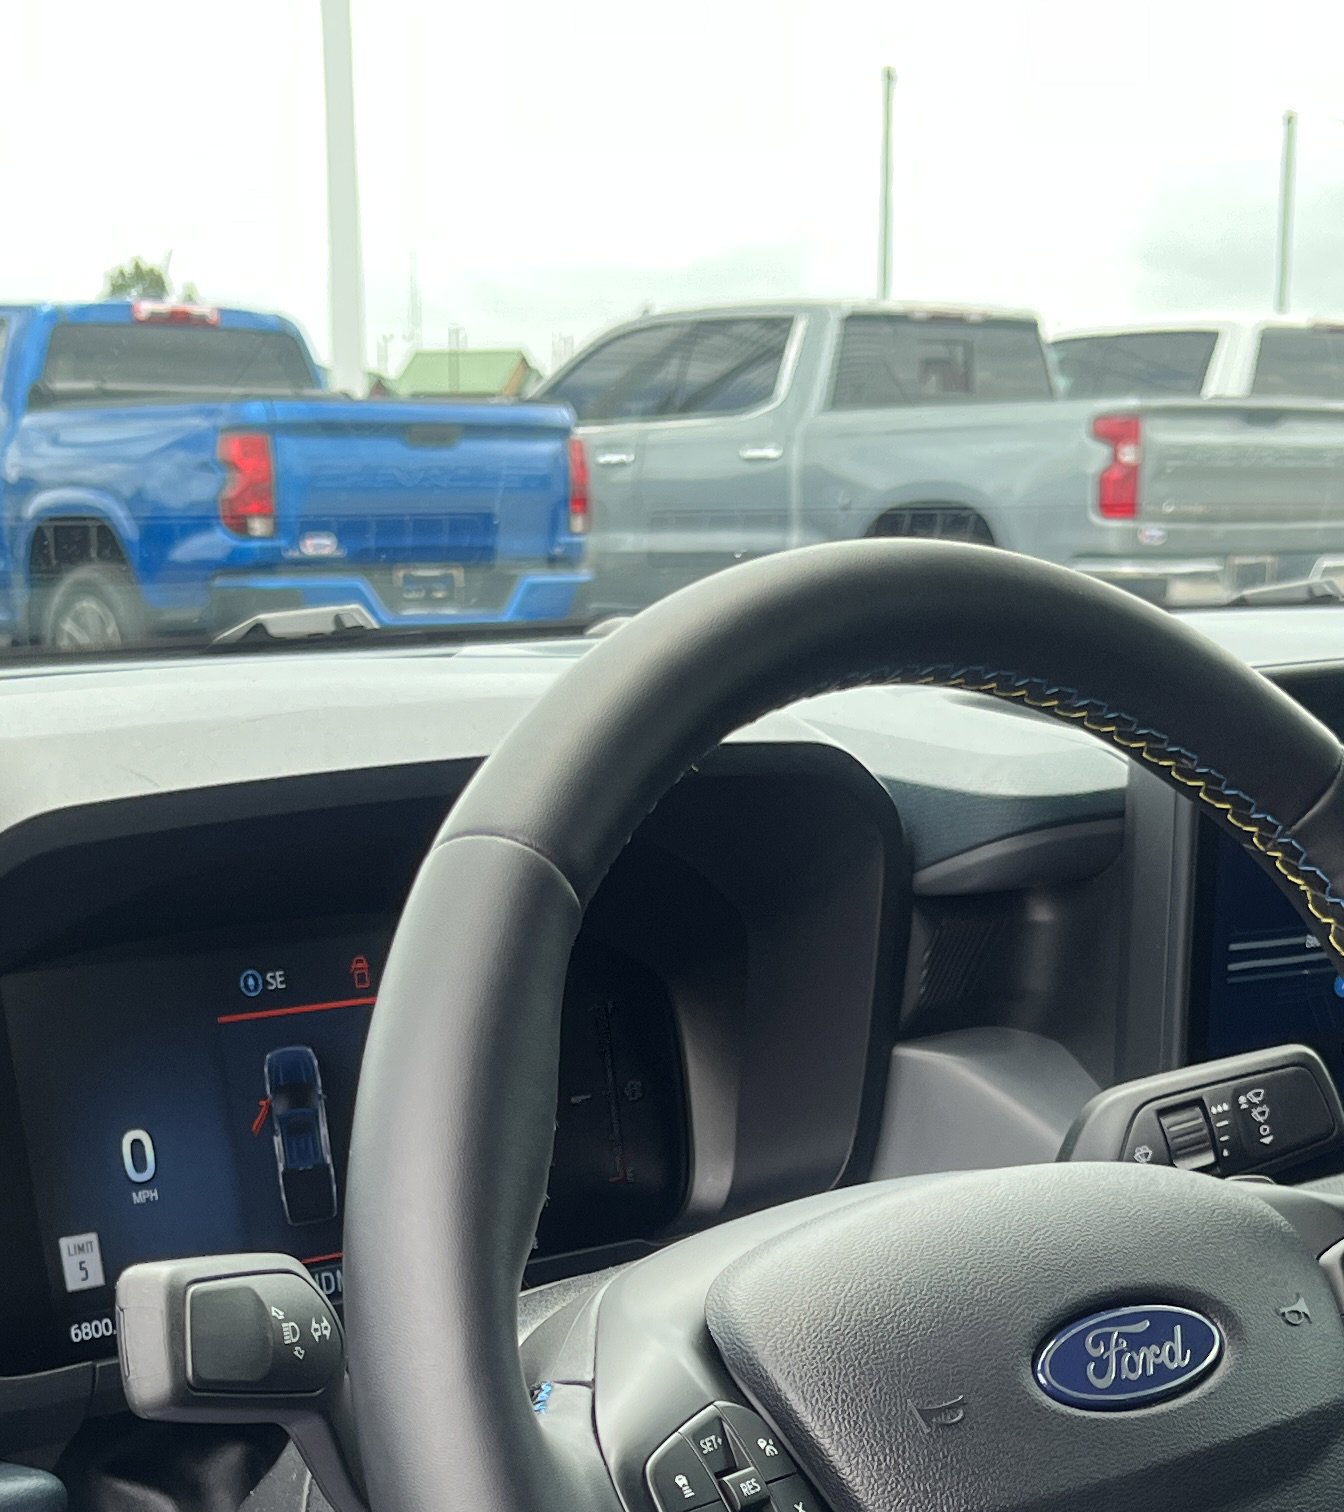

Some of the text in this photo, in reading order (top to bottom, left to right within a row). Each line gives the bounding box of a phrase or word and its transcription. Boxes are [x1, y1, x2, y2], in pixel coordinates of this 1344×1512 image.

[265, 970, 287, 990] SE
[121, 1128, 157, 1183] 0
[132, 1188, 159, 1204] MPH
[67, 1240, 94, 1257] LIMIT
[79, 1260, 89, 1282] 5
[1084, 1319, 1191, 1390] Ford
[699, 1434, 723, 1455] SET+
[739, 1477, 761, 1497] RES
